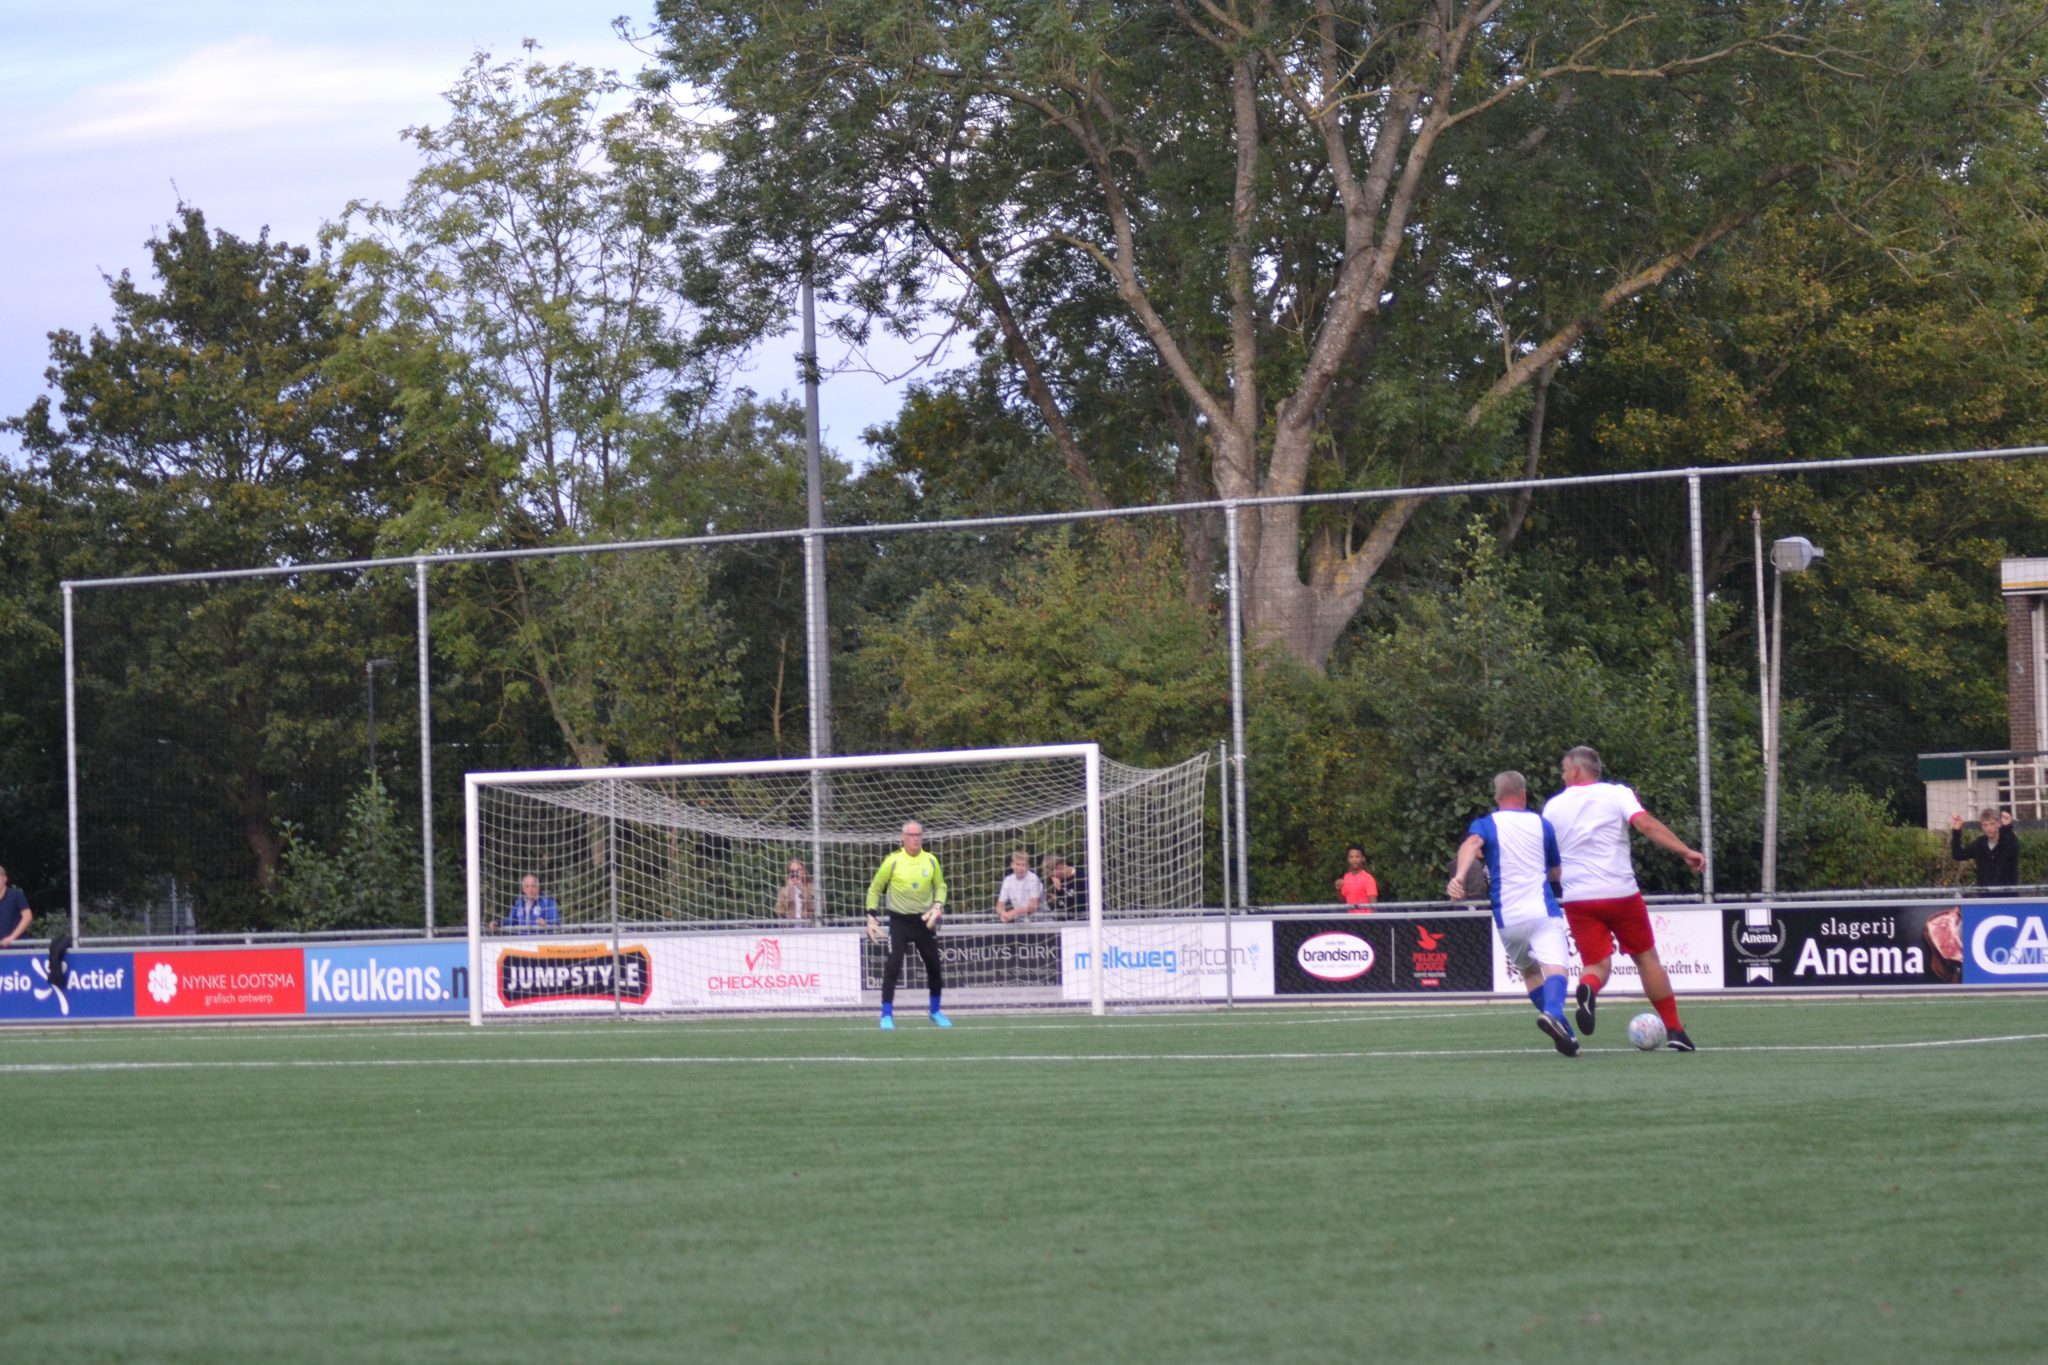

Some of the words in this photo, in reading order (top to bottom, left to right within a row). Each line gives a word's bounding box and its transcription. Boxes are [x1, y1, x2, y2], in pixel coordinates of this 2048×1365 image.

[1820, 917, 1895, 939] slagerij
[1741, 931, 1777, 943] Anema
[1019, 945, 1056, 960] DIRK
[1303, 948, 1369, 961] brandsma
[1794, 938, 1924, 975] Anema
[67, 968, 124, 990] Actief
[182, 975, 227, 989] NYNKE
[231, 973, 295, 989] LOOTSMA
[708, 973, 821, 990] CHECK&SAVE
[204, 992, 236, 1007] grafisch
[238, 993, 273, 1005] ontwerp
